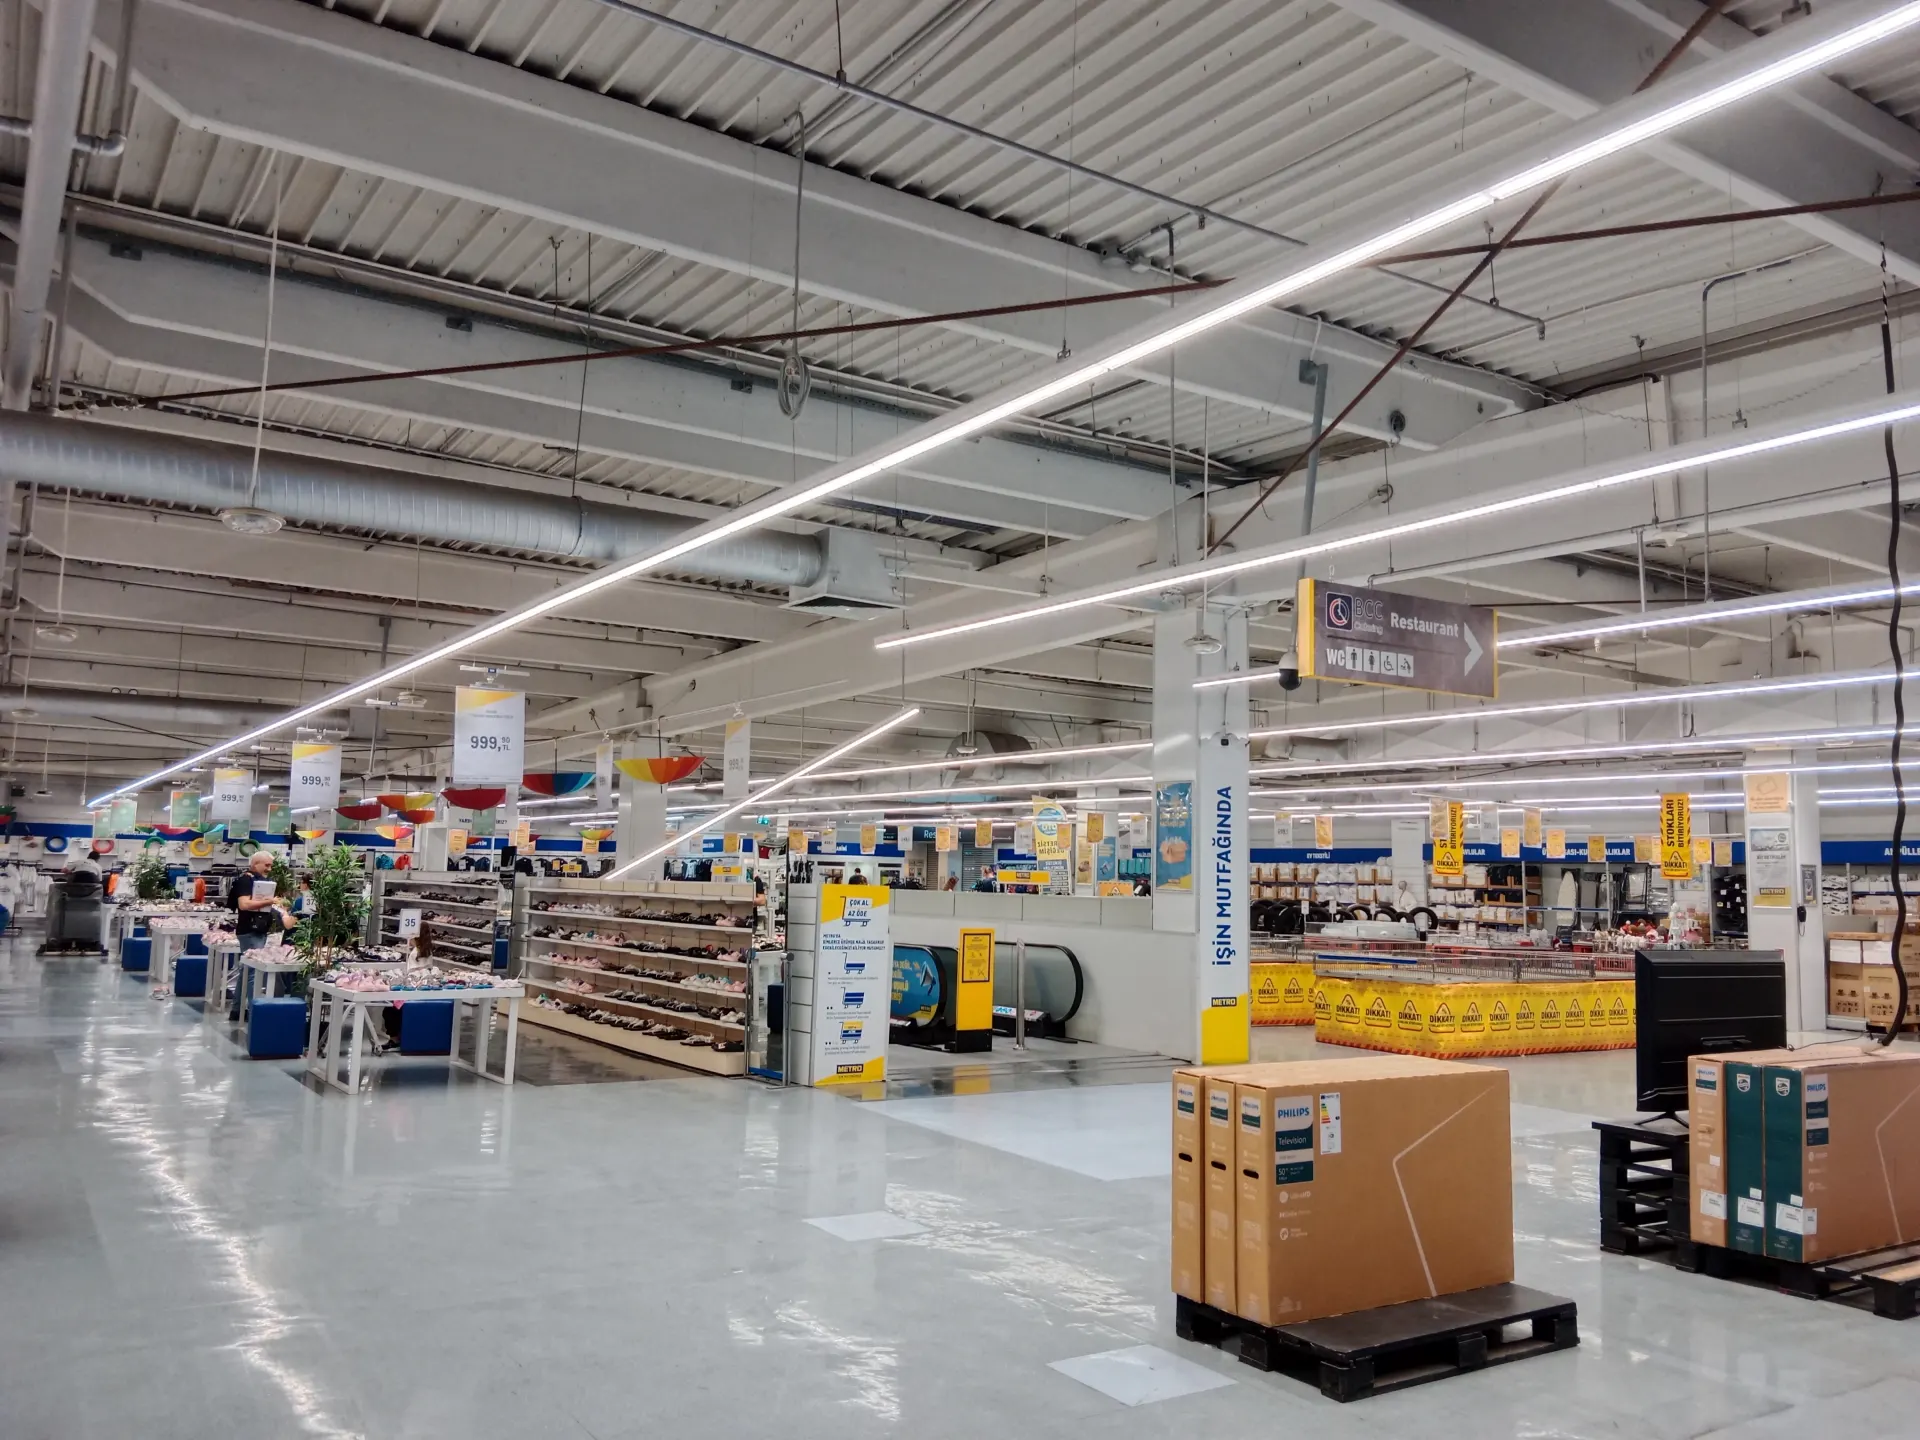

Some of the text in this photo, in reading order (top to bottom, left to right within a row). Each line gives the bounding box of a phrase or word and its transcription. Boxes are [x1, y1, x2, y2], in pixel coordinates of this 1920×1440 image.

[1355, 598, 1384, 620] BCC
[1390, 611, 1459, 637] Restaurant
[1326, 648, 1346, 666] WC
[1666, 799, 1675, 847] STOKLARI
[1212, 786, 1236, 966] İŞİN MUTFAĞINDA
[404, 918, 416, 927] 35
[1212, 998, 1236, 1006] METRO
[1315, 1003, 1331, 1011] KKAT!
[1336, 1004, 1360, 1015] DİKKAT!
[1365, 1008, 1391, 1018] DİKKAT!
[1565, 1010, 1585, 1018] DİKKAT!
[1398, 1011, 1422, 1021] DİKKAT!
[1429, 1014, 1455, 1023] DİKKAT!
[1462, 1014, 1483, 1022] DİKKAT!
[1489, 1012, 1509, 1021] DİKKAT!
[1541, 1011, 1560, 1019] DİKKAT!
[838, 1065, 863, 1073] METRO
[1277, 1106, 1310, 1119] PHILIPS
[1278, 1136, 1307, 1146] Television
